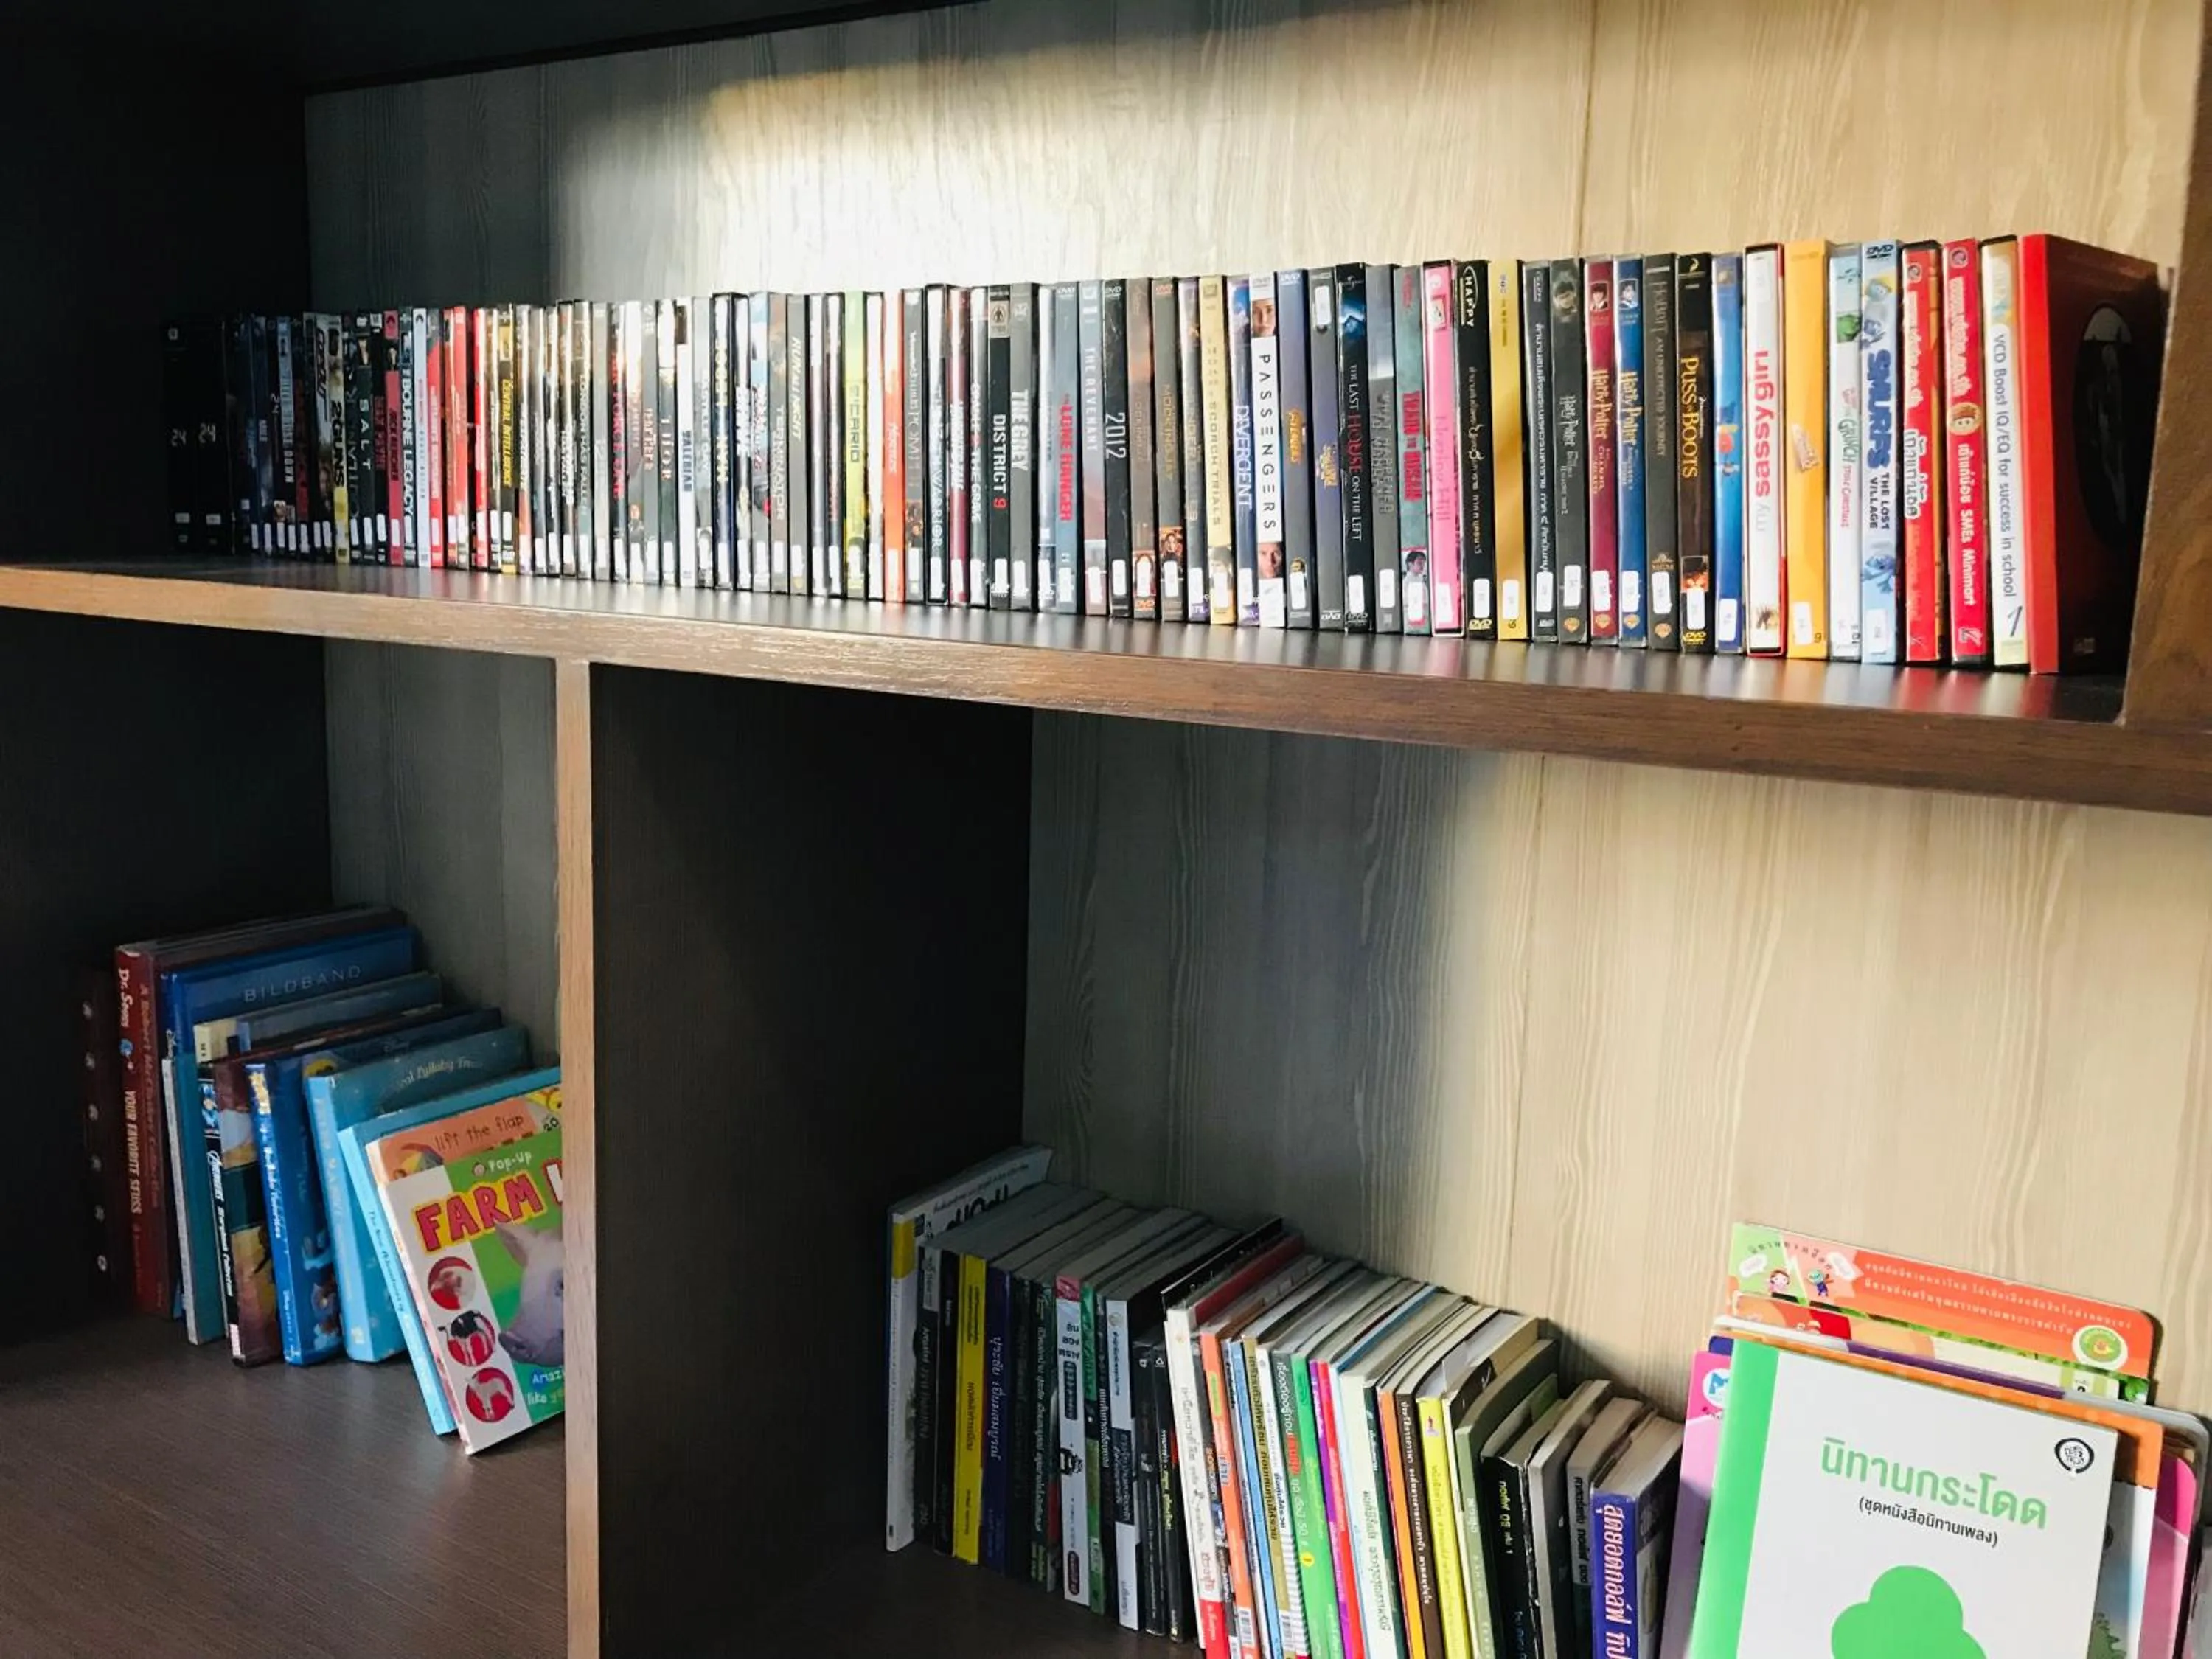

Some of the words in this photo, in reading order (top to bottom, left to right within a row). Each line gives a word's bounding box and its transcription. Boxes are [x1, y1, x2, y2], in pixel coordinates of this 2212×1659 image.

[1464, 275, 1476, 327] HAPPY
[1085, 347, 1098, 375] THE
[1993, 333, 2007, 364] VCD
[1349, 383, 1360, 411] LAST
[1590, 369, 1610, 403] Harry
[1621, 371, 1638, 406] Harry
[1680, 357, 1699, 404] PUSS
[1753, 349, 1775, 402] girl
[1993, 368, 2008, 406] Boost
[402, 375, 414, 446] BOURNE
[501, 378, 513, 422] CENTRAL
[1011, 389, 1029, 425] THE
[1085, 378, 1099, 452] REVENANT
[1593, 403, 1613, 440] Potter
[1865, 349, 1891, 470] SMURFS
[359, 399, 372, 470] SALT
[1012, 425, 1029, 471] GREY
[1059, 405, 1074, 450] LONE
[1107, 411, 1126, 459] 2012
[1208, 400, 1219, 470] SCORCH
[1258, 353, 1276, 531] PASSENGERS
[1346, 414, 1363, 473] HOUSE
[1622, 406, 1642, 446] Potter
[1681, 413, 1700, 479] BOOTS
[1837, 419, 1858, 464] GRINCH
[1994, 410, 2011, 453] IQ/EQ
[991, 413, 1007, 495] DISTRICT
[1234, 404, 1252, 511] DIVERGENT
[1753, 405, 1775, 499] sassy
[1997, 459, 2011, 478] for
[403, 449, 415, 515] LEGACY
[992, 495, 1007, 509] 9
[1060, 453, 1074, 521] RANGER
[1211, 473, 1222, 526] TRIALS
[1352, 476, 1361, 493] ON
[1352, 494, 1362, 513] THE
[1868, 476, 1880, 530] VILLAGE
[1880, 472, 1891, 501] THE
[931, 469, 944, 550] WARRIOR
[1352, 515, 1364, 540] LEFT
[1880, 504, 1891, 531] LOST
[1959, 507, 1974, 541] SMEs
[1998, 482, 2011, 532] success
[2000, 537, 2014, 551] in
[1961, 546, 1978, 603] Minimart
[2002, 554, 2017, 597] school
[117, 968, 130, 990] Dr.
[243, 964, 361, 1003] BILDBAND
[124, 1091, 138, 1121] YOUR
[126, 1123, 140, 1175] FAVORITE
[434, 1132, 462, 1154] lift
[466, 1122, 492, 1144] the
[494, 1112, 525, 1135] flap
[129, 1178, 142, 1215] SEUSS
[414, 1171, 546, 1253] FARM
[1820, 1436, 2048, 1530] นิทานกระโดด
[1858, 1495, 1999, 1548] (ชุดหนังสือนิทานเพลง)
[1594, 1503, 1632, 1627] สุดยอดกอล์ฟ
